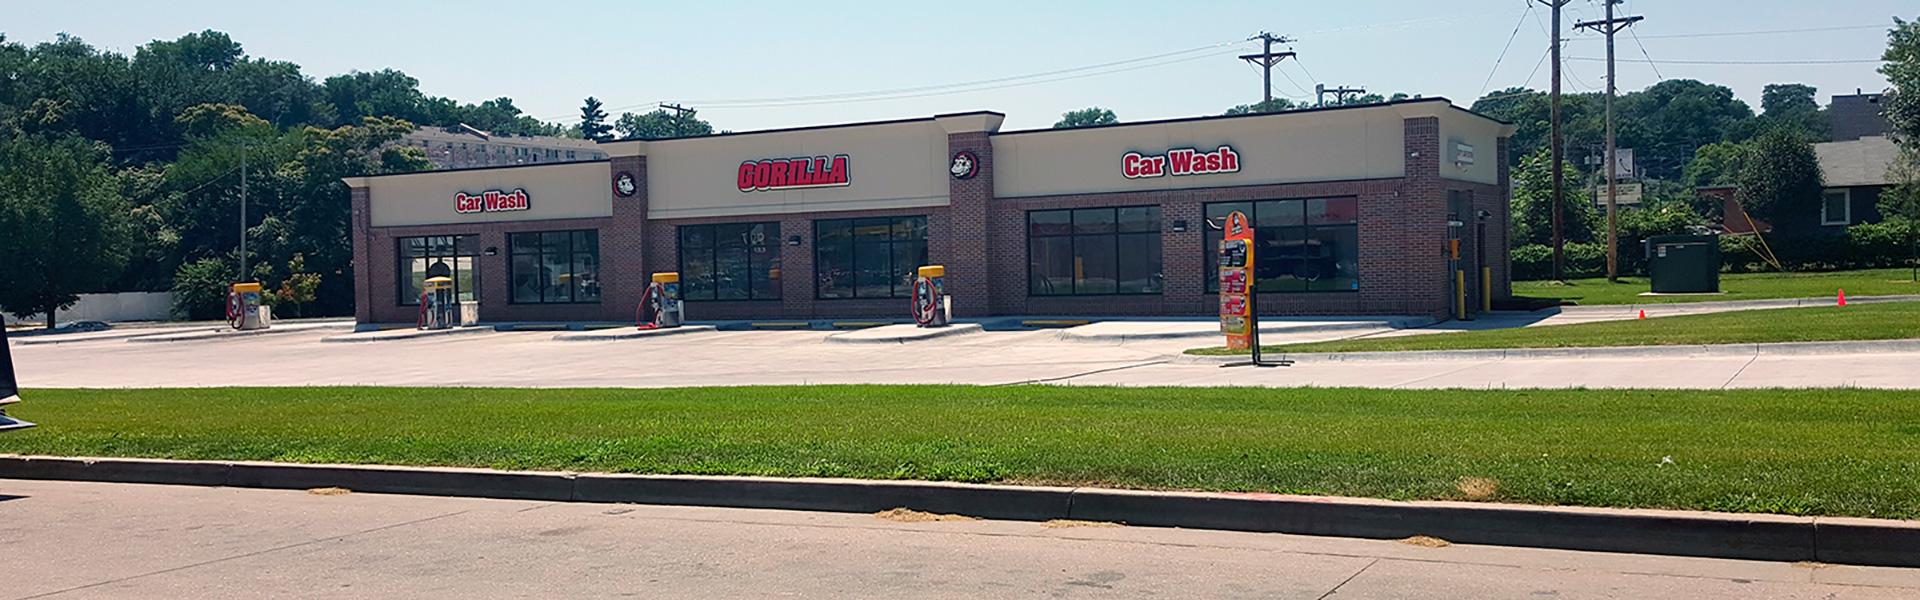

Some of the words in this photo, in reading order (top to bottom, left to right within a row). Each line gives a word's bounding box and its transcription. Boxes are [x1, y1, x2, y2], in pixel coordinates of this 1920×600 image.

[738, 155, 849, 190] GORILLA
[1123, 153, 1164, 177] Car
[1169, 146, 1238, 175] Wash
[455, 193, 481, 212] Car
[484, 189, 527, 211] Wash
